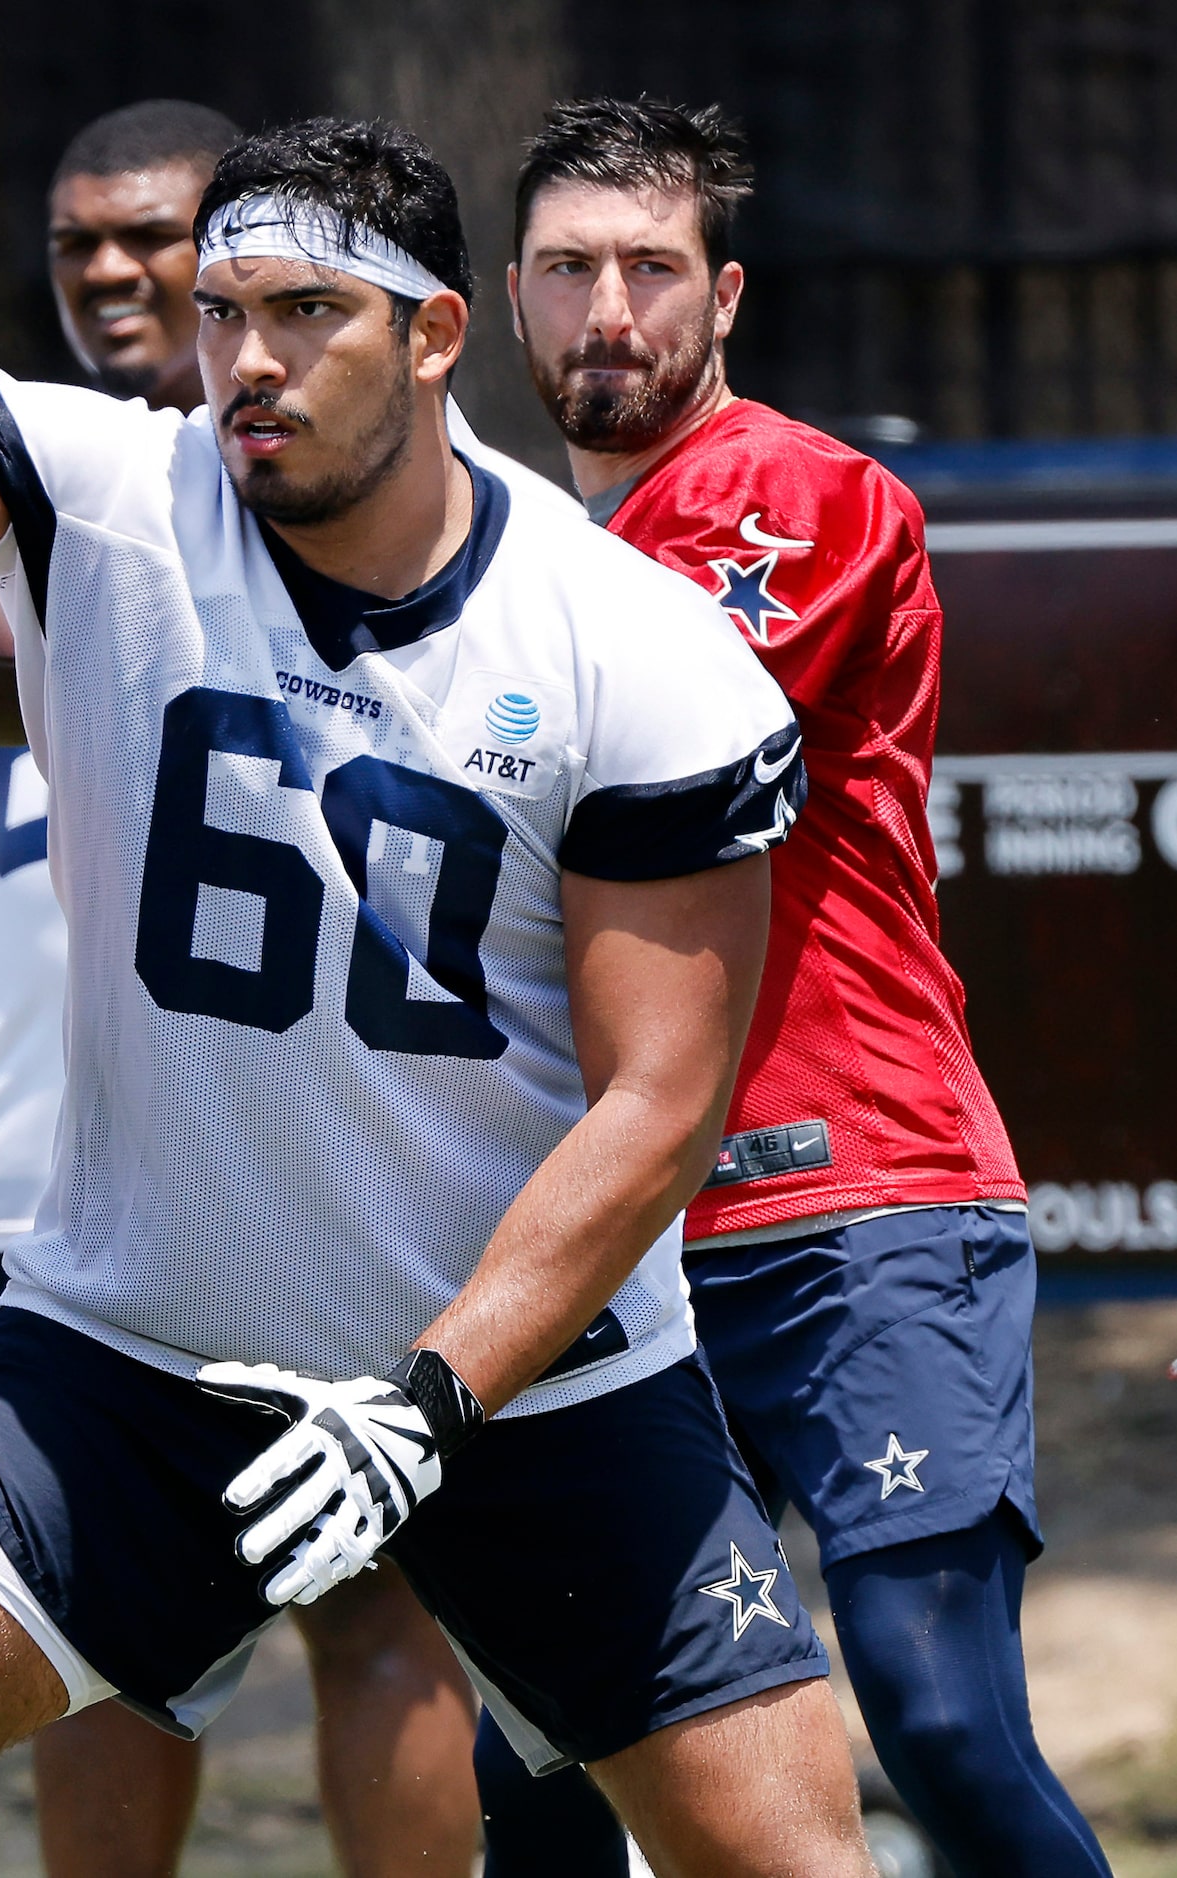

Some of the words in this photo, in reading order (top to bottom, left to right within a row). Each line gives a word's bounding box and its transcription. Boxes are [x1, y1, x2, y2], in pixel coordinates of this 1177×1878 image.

[276, 670, 382, 719] COWBOYS
[464, 748, 536, 783] AT&T
[134, 686, 510, 1061] 60
